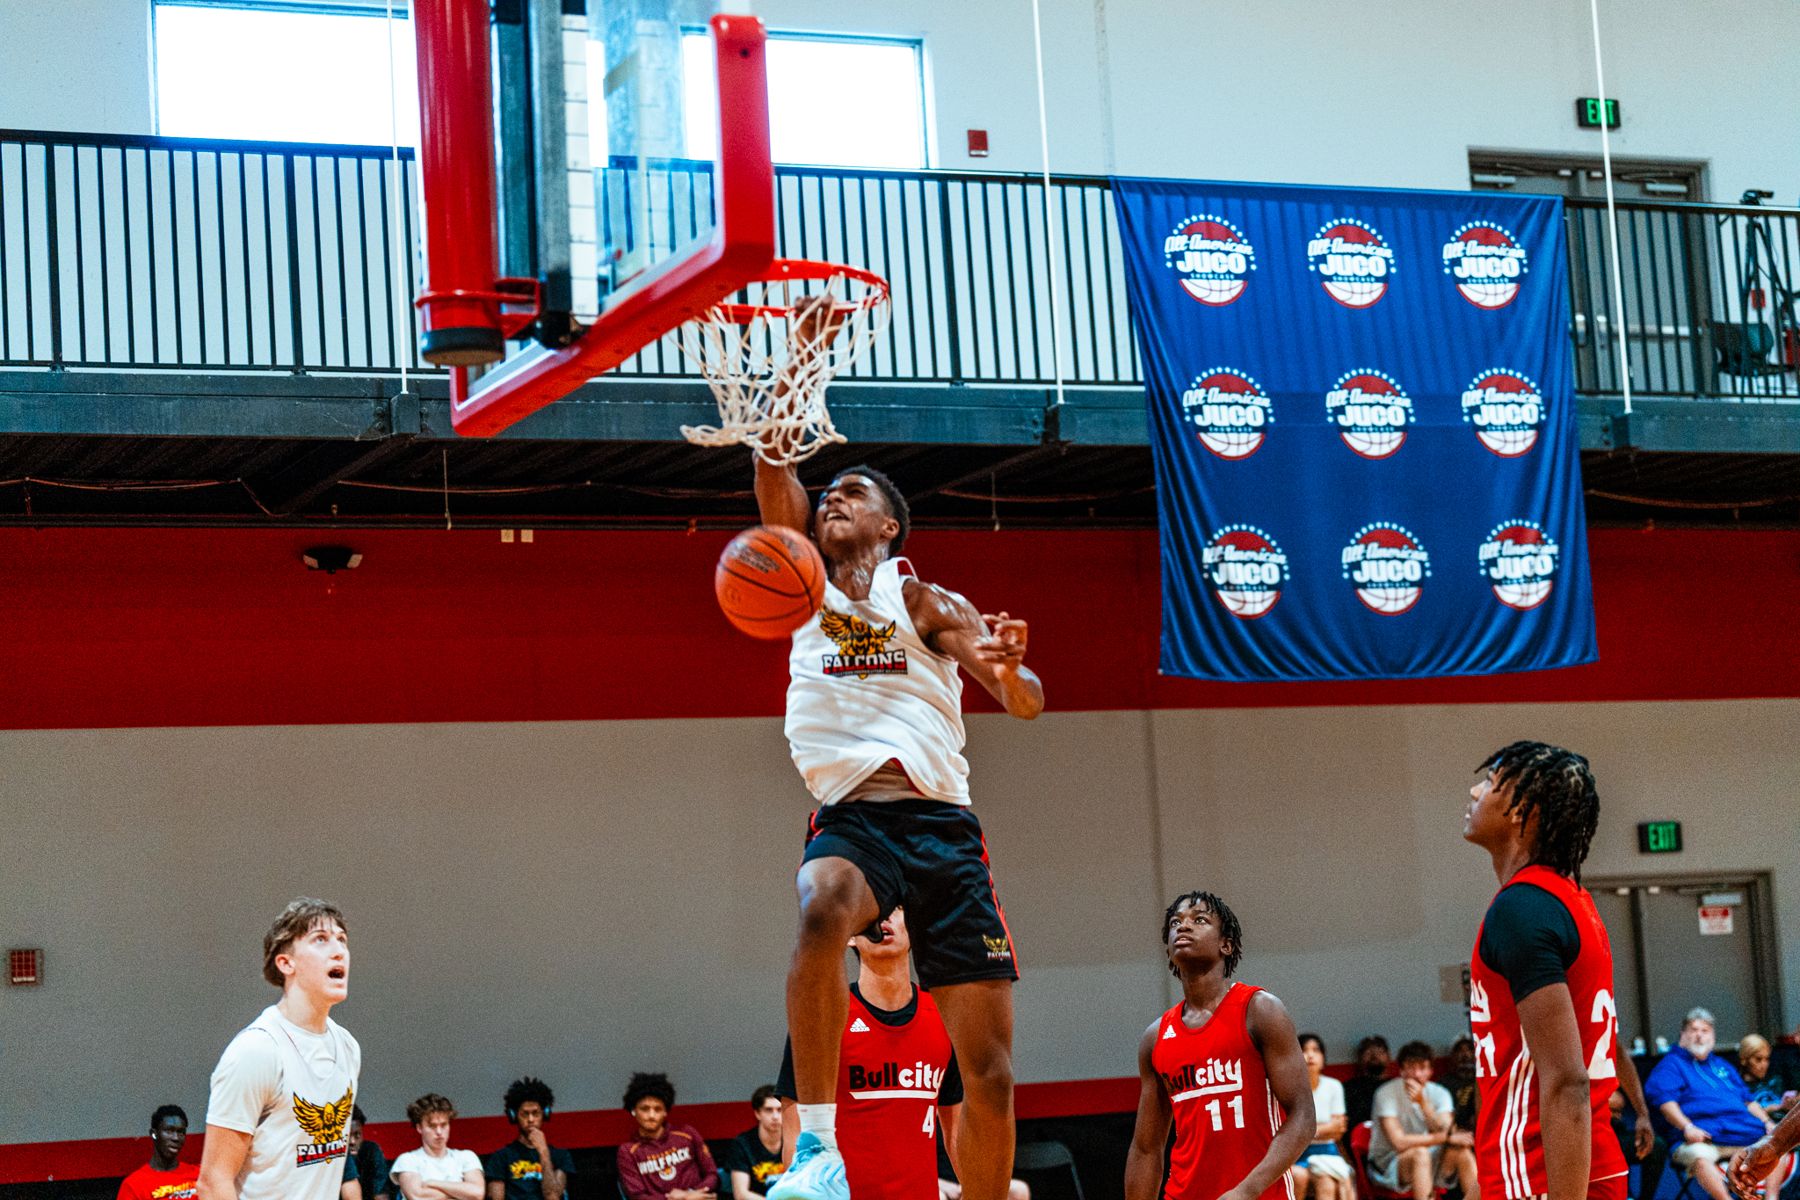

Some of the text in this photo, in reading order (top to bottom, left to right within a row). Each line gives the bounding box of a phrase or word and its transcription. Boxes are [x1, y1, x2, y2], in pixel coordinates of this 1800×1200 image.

[1176, 251, 1246, 274] JUCO
[1318, 254, 1387, 277] JUCO
[1453, 257, 1520, 278] JUCO
[1194, 404, 1265, 427] JUCO
[1337, 405, 1406, 427] JUCO
[1472, 403, 1539, 426] JUCO
[1212, 562, 1280, 585] JUCO
[1352, 560, 1422, 583] JUCO
[1489, 554, 1554, 579] JUCO
[822, 649, 908, 674] FALCONS
[1587, 988, 1619, 1080] 2
[848, 1060, 946, 1099] Bullcity
[922, 1105, 935, 1139] 4
[1204, 1094, 1245, 1132] 11
[297, 1138, 347, 1163] FALCO
[637, 1156, 665, 1175] WOLF
[665, 1146, 691, 1167] PACK
